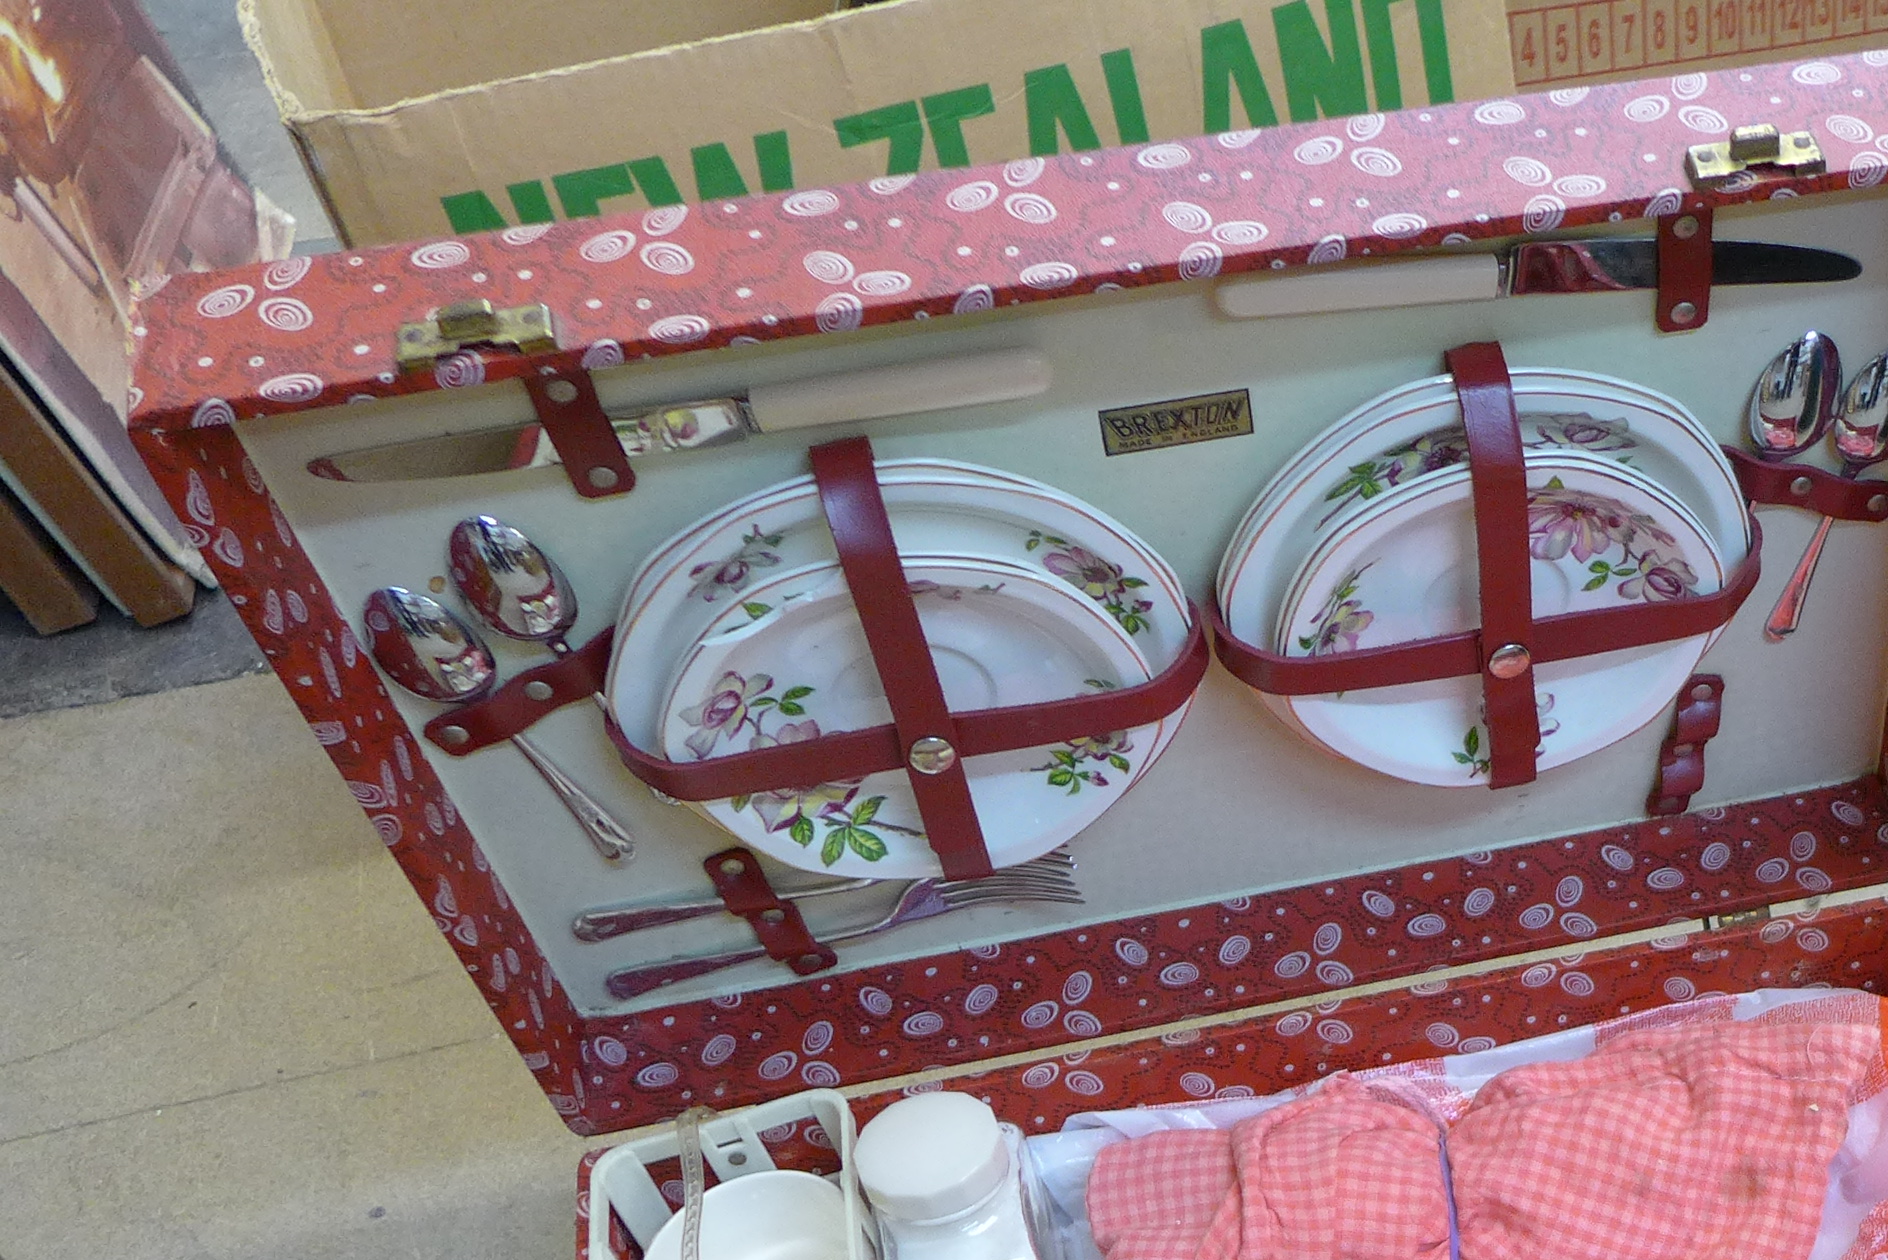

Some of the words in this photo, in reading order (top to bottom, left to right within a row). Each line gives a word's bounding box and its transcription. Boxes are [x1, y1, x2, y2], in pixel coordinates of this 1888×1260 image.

[1521, 27, 1536, 68] 4
[1555, 23, 1569, 63] 5
[1588, 18, 1602, 59] 6
[1621, 13, 1636, 54] 7
[1653, 9, 1666, 50] 8
[1685, 5, 1699, 45] 9
[1714, 0, 1737, 40] 10
[1748, 0, 1767, 36] 11
[1779, 0, 1800, 30] 12
[1104, 398, 1245, 439] BREXTON
[1118, 438, 1152, 449] MADE
[1181, 423, 1240, 440] ENGLAND
